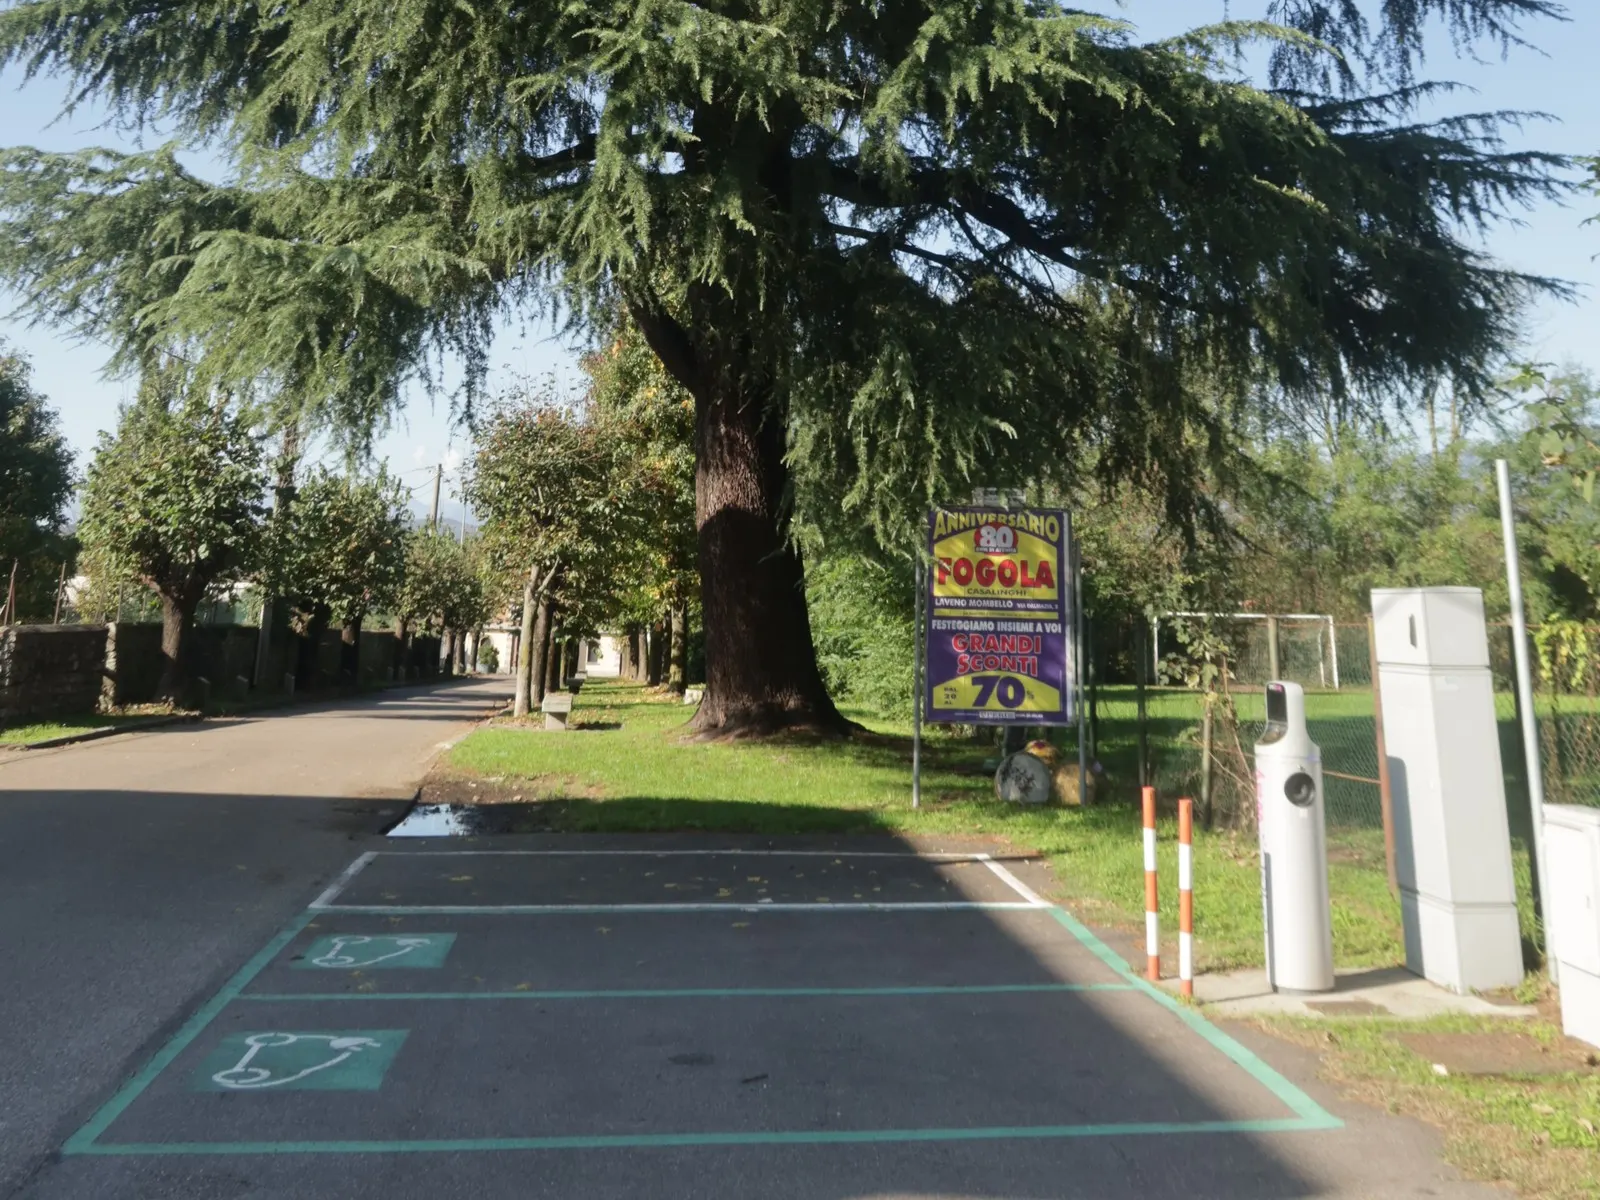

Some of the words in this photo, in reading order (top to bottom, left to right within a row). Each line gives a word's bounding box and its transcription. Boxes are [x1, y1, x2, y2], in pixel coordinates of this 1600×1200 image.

[933, 511, 1060, 542] ANNIVERSARIO
[980, 525, 1014, 548] 80
[938, 557, 1055, 589] FOGOLA
[935, 598, 966, 607] LAVENO
[969, 599, 1013, 608] MOMBELLO
[967, 588, 1027, 596] CASALINGHI
[932, 620, 995, 631] FESTEGGIAMO
[997, 622, 1034, 632] INSIEME
[1036, 623, 1043, 632] A
[1044, 623, 1061, 633] VOI
[952, 633, 1041, 654] GRANDI
[957, 654, 1038, 677] SCONTI
